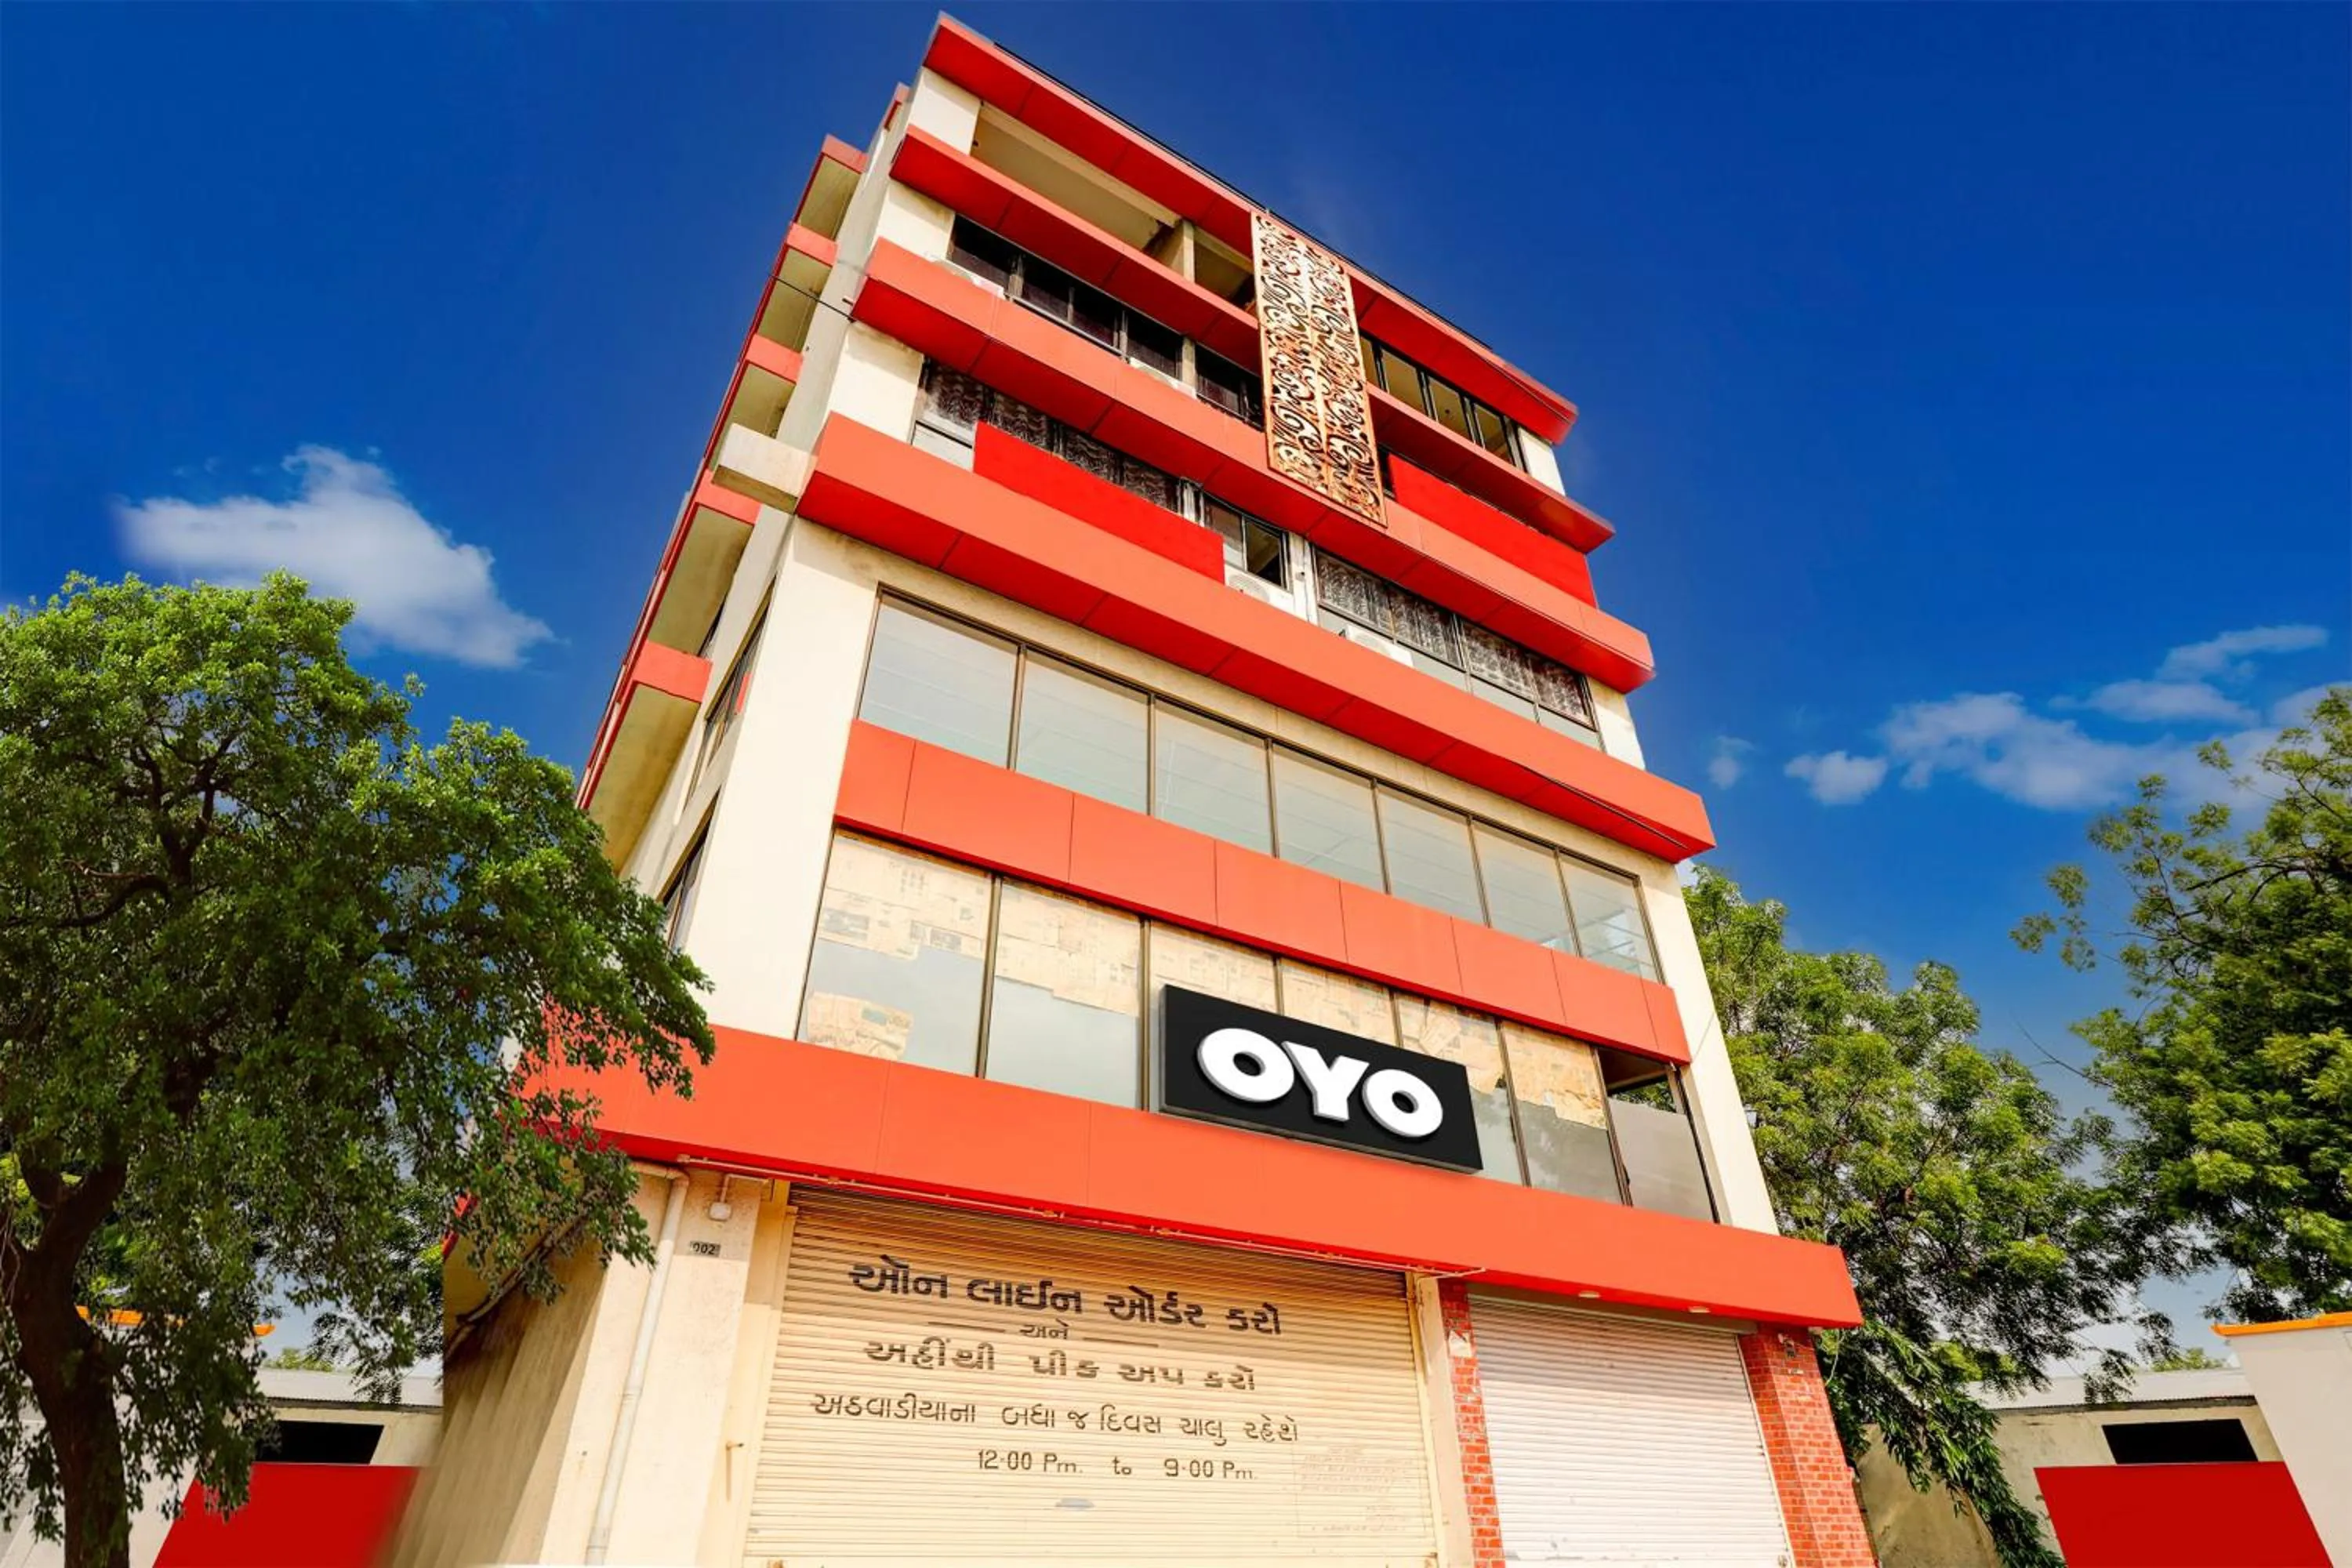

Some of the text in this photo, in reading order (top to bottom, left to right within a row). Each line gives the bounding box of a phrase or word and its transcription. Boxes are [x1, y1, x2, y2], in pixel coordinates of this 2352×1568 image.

[1197, 1028, 1443, 1137] OYO
[967, 1278, 1083, 1314] લાઈન
[1104, 1285, 1207, 1328] ઓર્ડર
[1225, 1301, 1282, 1334] કરો
[1019, 1318, 1069, 1340] અને
[863, 1336, 995, 1370] અહીંથી
[1117, 1363, 1184, 1385] અપ
[1204, 1364, 1254, 1391] કરો
[811, 1392, 1298, 1446] અઠવાડીયાના બધા જ દિવસ ચાલુ રહેશે
[1112, 1456, 1133, 1475] to
